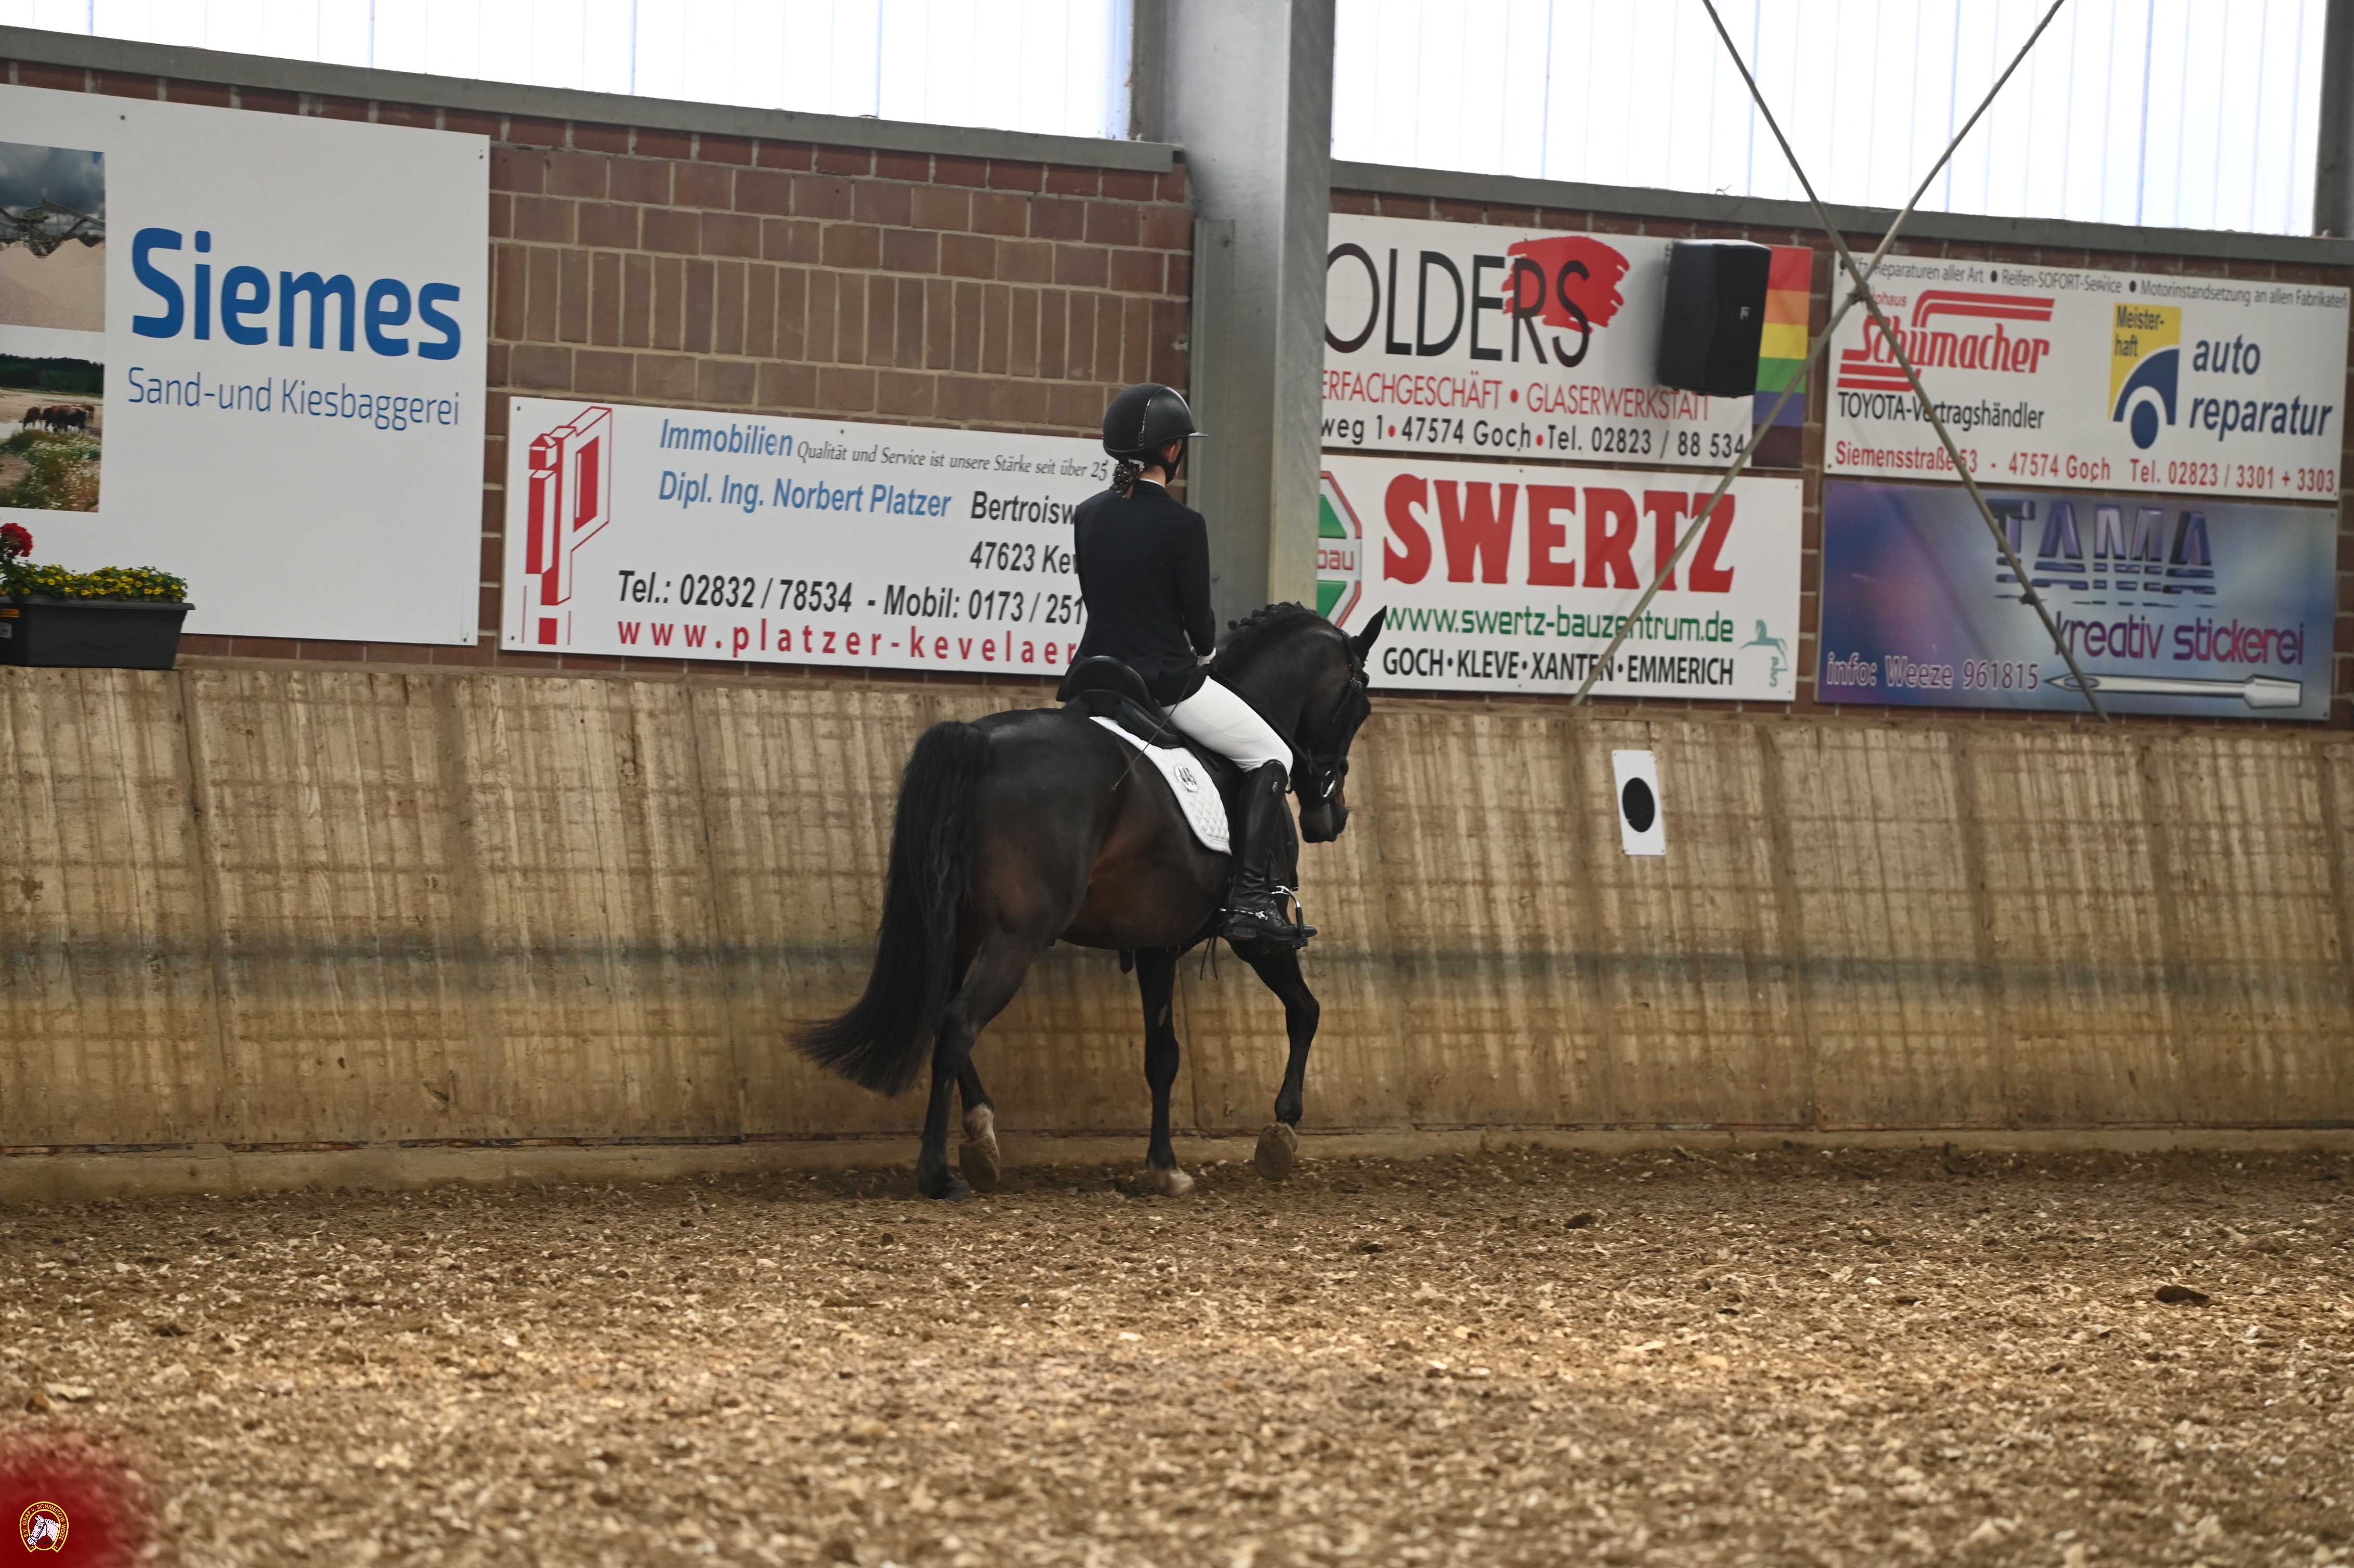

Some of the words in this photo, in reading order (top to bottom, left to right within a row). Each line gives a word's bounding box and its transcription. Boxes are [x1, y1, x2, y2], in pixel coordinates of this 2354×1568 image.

[132, 227, 461, 360] Siemes
[1943, 264, 1966, 281] aller
[1967, 266, 1983, 283] Art
[2140, 280, 2251, 307] Motorinstandsetzung
[2254, 290, 2268, 303] an
[2269, 287, 2293, 305] allen
[2296, 290, 2348, 309] Fabrikaten
[2116, 305, 2164, 331] Meister-
[1840, 313, 2050, 374] Schumacher
[2114, 333, 2139, 358] haft
[2192, 333, 2261, 376] auto
[128, 366, 272, 412] Sand-und
[282, 378, 460, 431] Kiesbaggerei
[2189, 395, 2333, 441] reparatur
[660, 419, 794, 456] Immobilien
[1377, 415, 1383, 440] 1
[1402, 415, 1464, 445] 47574
[1474, 419, 1531, 448] Goch
[1548, 424, 1582, 451] Tel.
[1591, 426, 1652, 454] 02823
[1660, 429, 1669, 459] /
[1678, 431, 1701, 456] 88
[1709, 433, 1746, 458] 534
[797, 440, 847, 463] Qualität
[853, 445, 879, 463] und
[881, 447, 926, 466] Service
[930, 451, 945, 467] ist
[950, 455, 990, 471] unsere
[995, 454, 1032, 473] Stärke
[1035, 460, 1056, 475] seit
[1061, 458, 1088, 477] über
[1091, 459, 1108, 481] 25
[1836, 440, 1957, 471] Siemensstraße
[2008, 451, 2059, 478] 47574
[2066, 454, 2110, 481] Goch
[2130, 459, 2160, 483] Tel.
[2168, 461, 2218, 486] 02823
[2237, 465, 2274, 489] 3301
[2281, 474, 2291, 484] +
[2297, 468, 2335, 493] 3303
[659, 470, 712, 509] Dipl.
[721, 474, 764, 514] Ing.
[773, 478, 864, 513] Norbert
[870, 484, 952, 517] Platzer
[1383, 473, 1736, 593] SWERTZ
[1986, 498, 2216, 594] TAMA
[970, 540, 1035, 573] 47623
[619, 570, 672, 604] Tel.:
[680, 573, 755, 608] 02832
[761, 578, 774, 609] /
[779, 579, 853, 613] 78534
[883, 584, 960, 618] Mobil:
[969, 589, 1024, 622] 0173
[1029, 592, 1041, 623] /
[1385, 604, 1734, 643] www.swertz-bauzentrum.de
[2055, 611, 2164, 659] kreativ
[2173, 622, 2305, 666] stickerei
[1383, 646, 1444, 677] GOCH
[1457, 649, 1520, 679] KLEVE
[1532, 652, 1614, 682] XANTEN
[1628, 654, 1734, 686] EMMERICH
[1825, 651, 1878, 688] info:
[1885, 655, 1953, 690] Weeze
[1963, 659, 2039, 692] 961815
